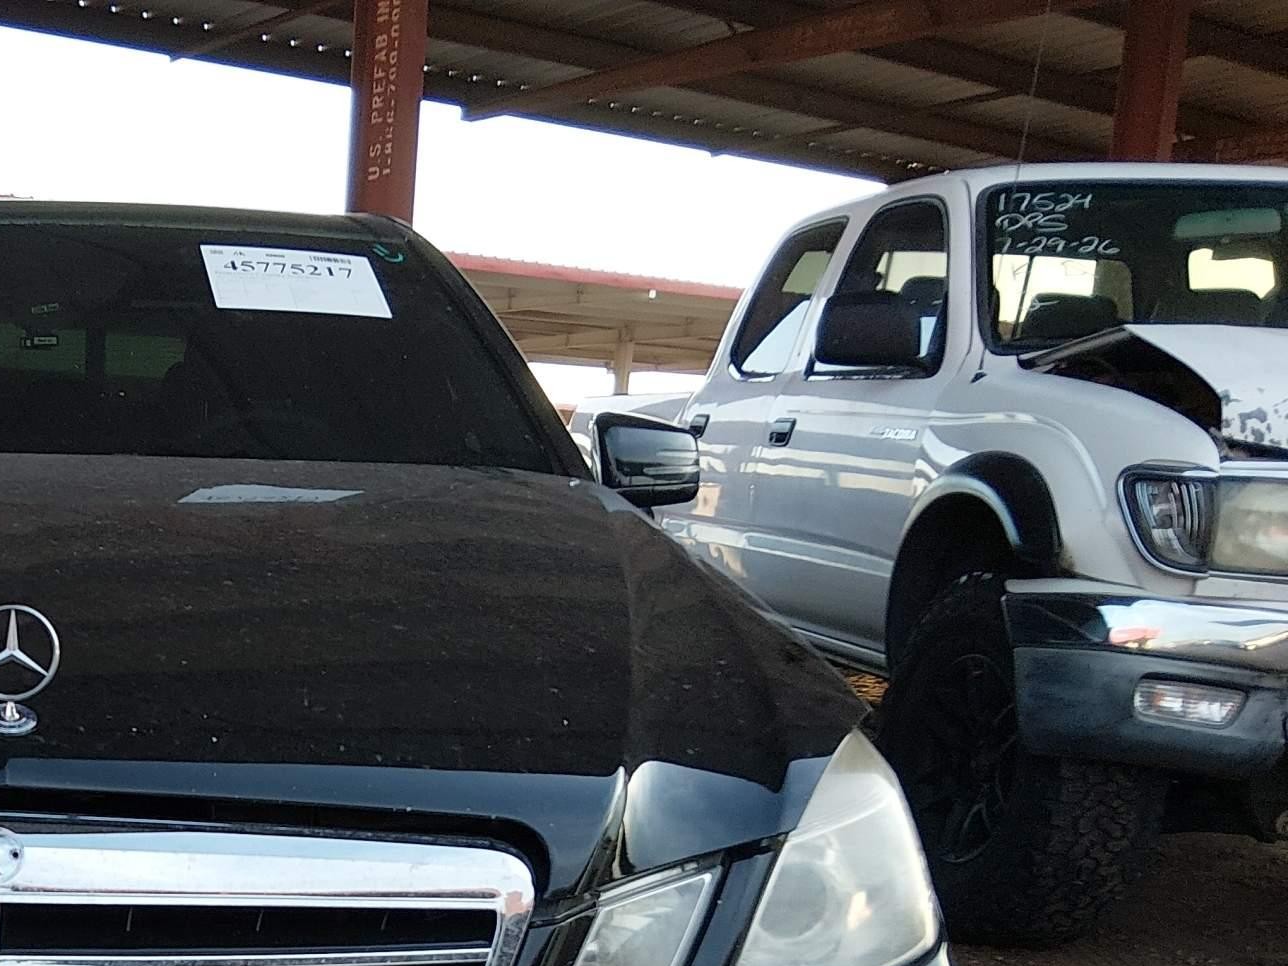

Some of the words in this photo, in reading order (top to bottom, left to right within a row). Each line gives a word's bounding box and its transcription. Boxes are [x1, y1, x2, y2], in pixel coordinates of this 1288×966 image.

[371, 33, 388, 125] PREFAB
[997, 192, 1093, 212] 17524
[223, 259, 353, 279] 45775217
